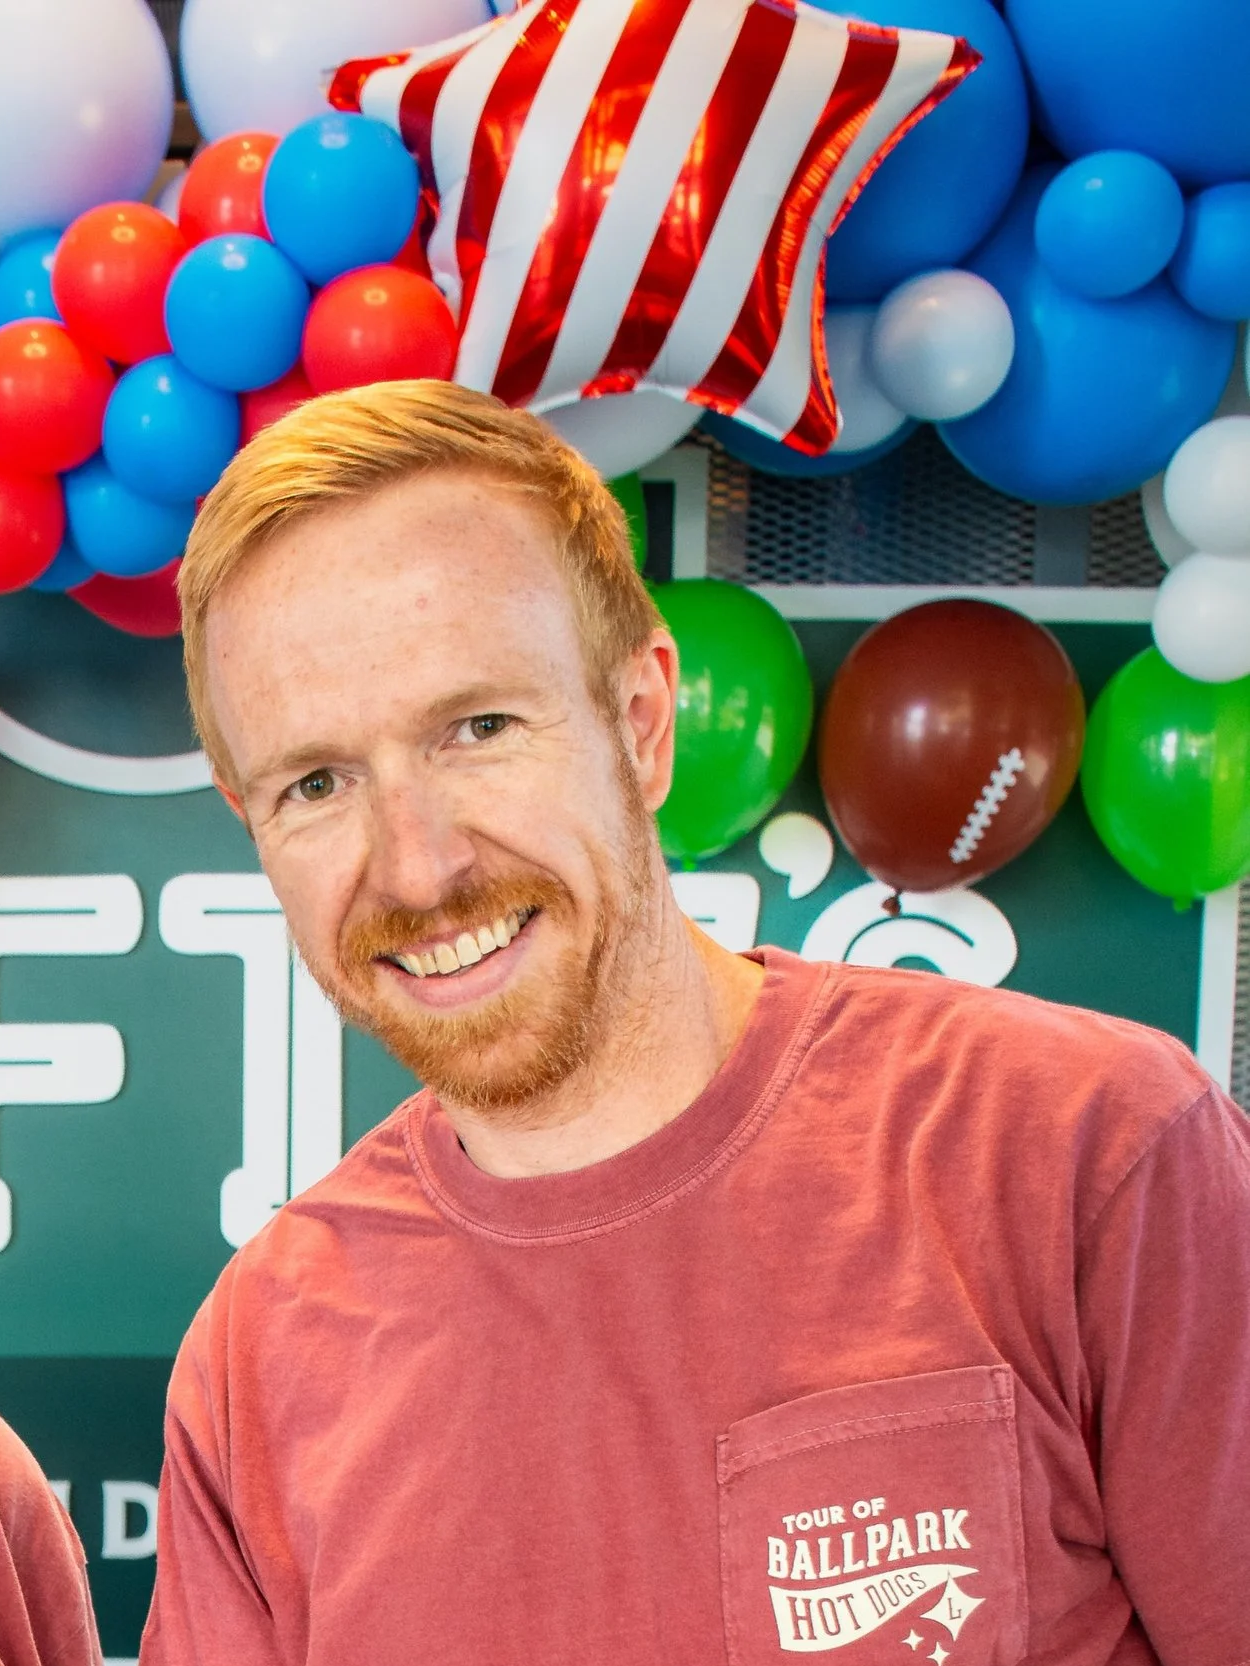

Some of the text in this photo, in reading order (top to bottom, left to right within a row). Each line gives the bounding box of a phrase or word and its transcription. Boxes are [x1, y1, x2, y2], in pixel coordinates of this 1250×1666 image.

[767, 1508, 971, 1581] BALLPARK
[782, 1496, 886, 1535] TOUR OF
[785, 1571, 926, 1640] HOT DOGS
